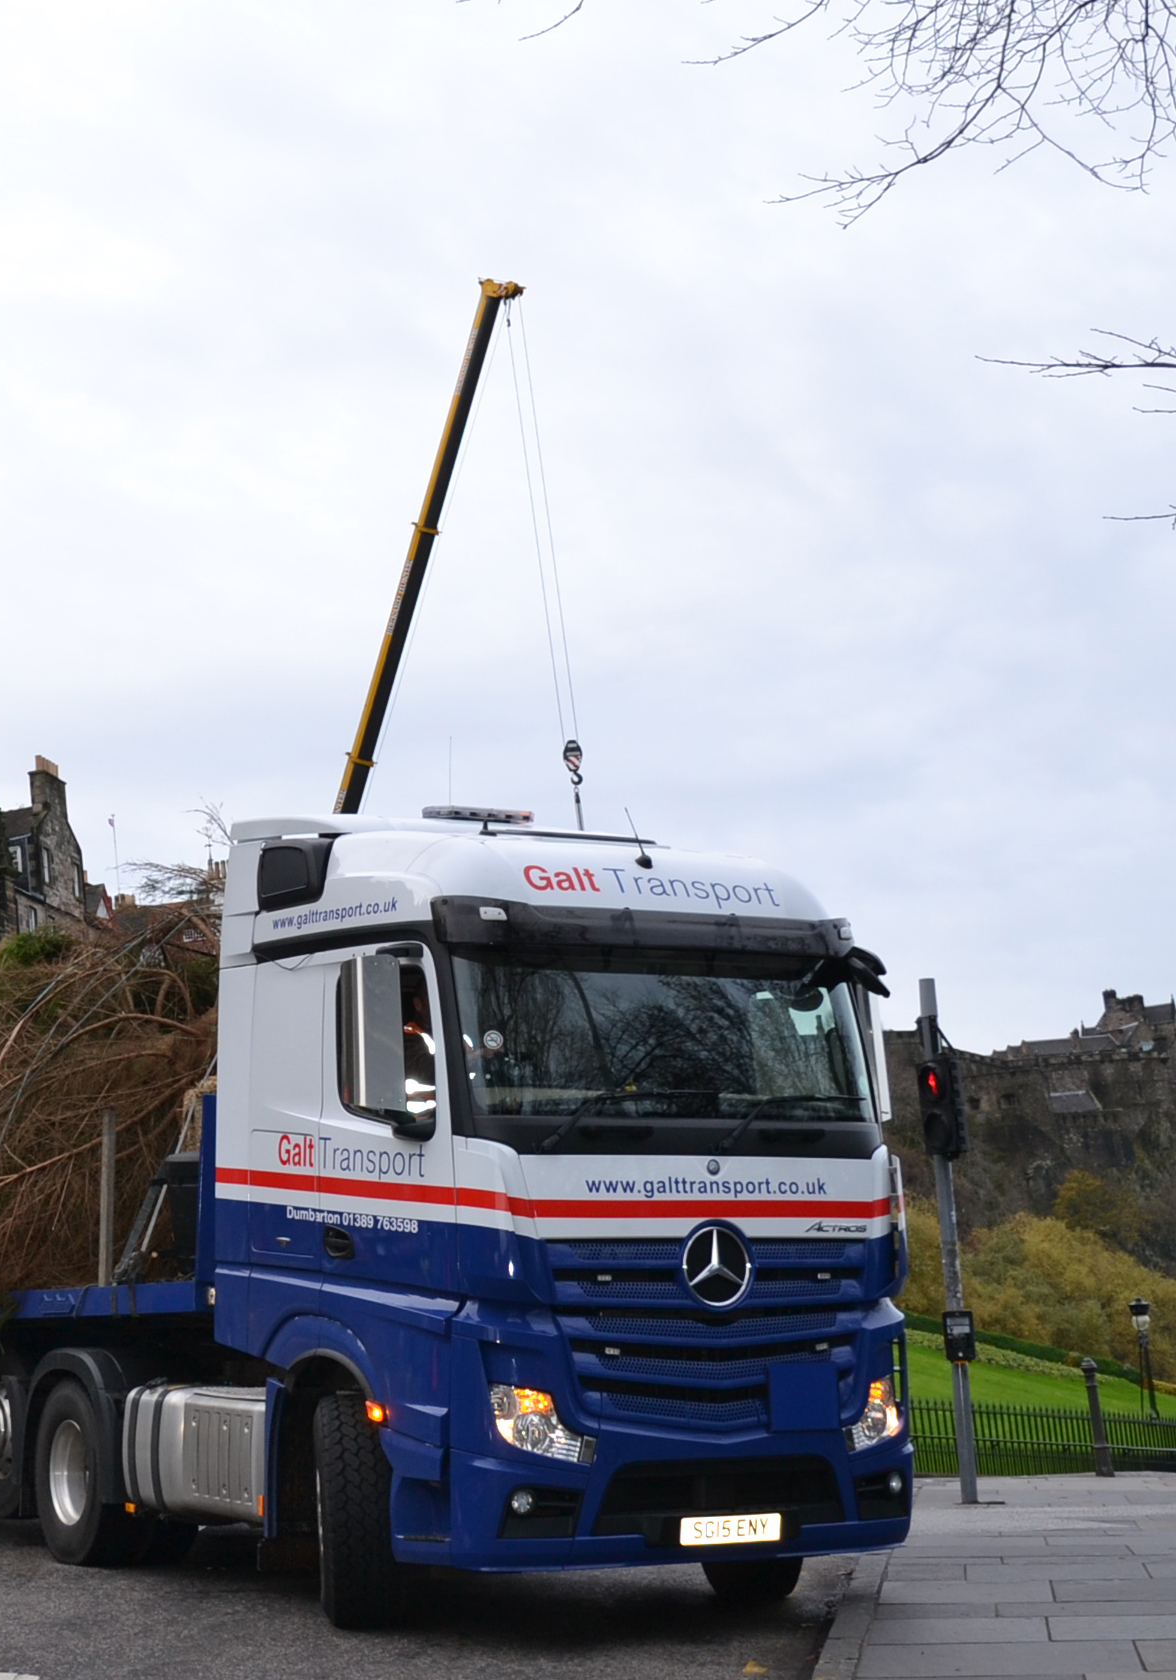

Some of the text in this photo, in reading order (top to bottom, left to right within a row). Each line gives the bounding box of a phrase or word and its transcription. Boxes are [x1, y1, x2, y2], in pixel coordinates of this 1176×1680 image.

[398, 559, 413, 594] HUNTER
[523, 864, 781, 909] Galt Transport
[272, 896, 398, 930] www.galttransport.co.uk
[278, 1134, 425, 1180] Galt Transport
[586, 1176, 827, 1199] www.galttransport.co.uk
[286, 1205, 419, 1234] Dumbarton 01389 763598
[693, 1518, 769, 1539] SG15 ENY
